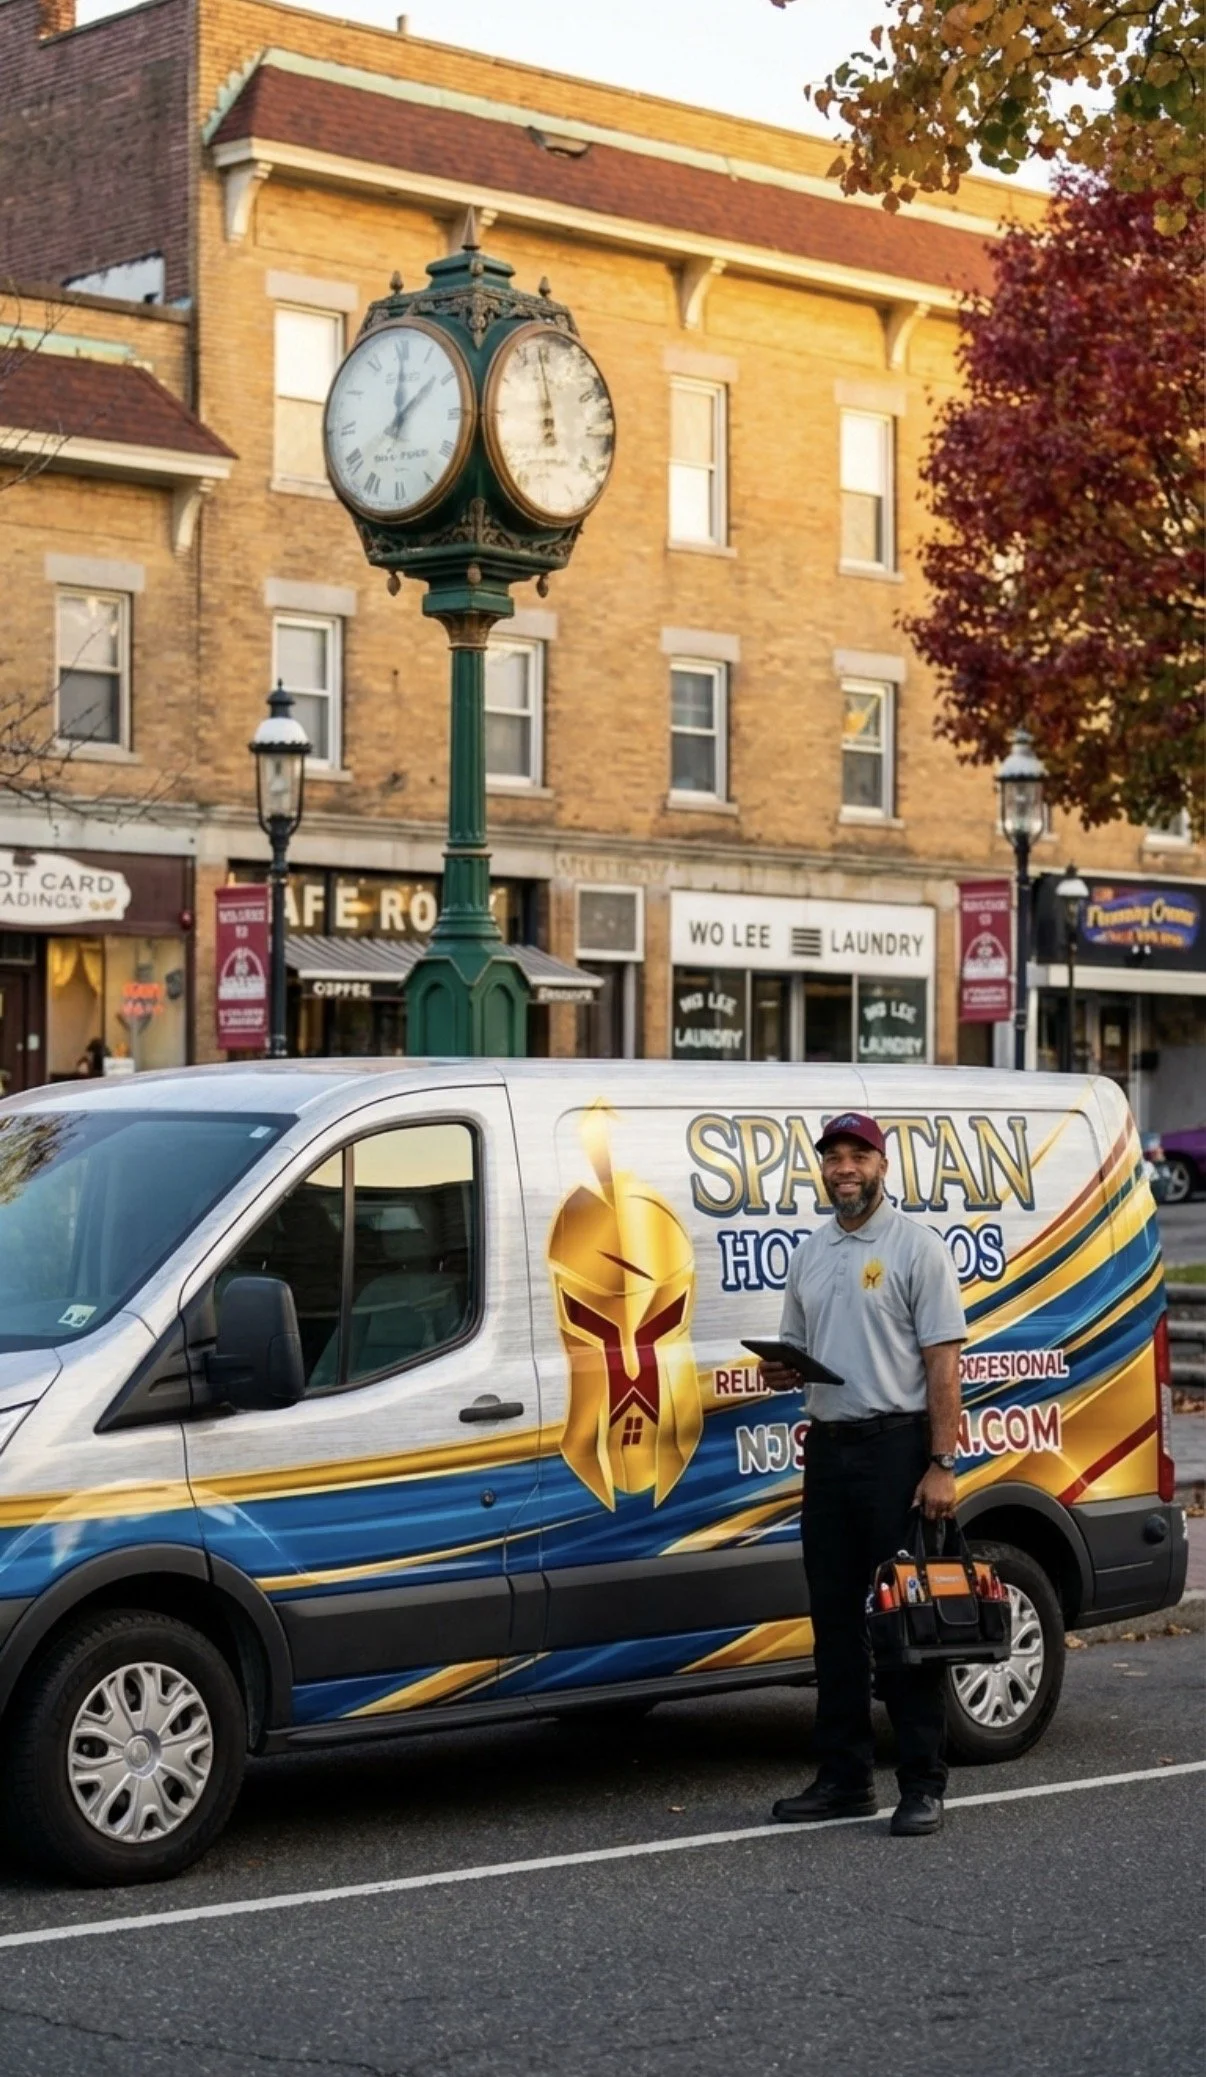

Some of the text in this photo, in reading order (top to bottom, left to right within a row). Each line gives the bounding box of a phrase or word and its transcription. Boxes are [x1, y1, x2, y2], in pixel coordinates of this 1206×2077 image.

[0, 869, 115, 893] OT CARD
[1, 891, 83, 910] ADINGS
[284, 884, 438, 932] AFE RO
[689, 920, 924, 957] WO LEE LAUNDRY
[686, 1112, 1036, 1218] SPATAN
[717, 1223, 1006, 1292] HO OS
